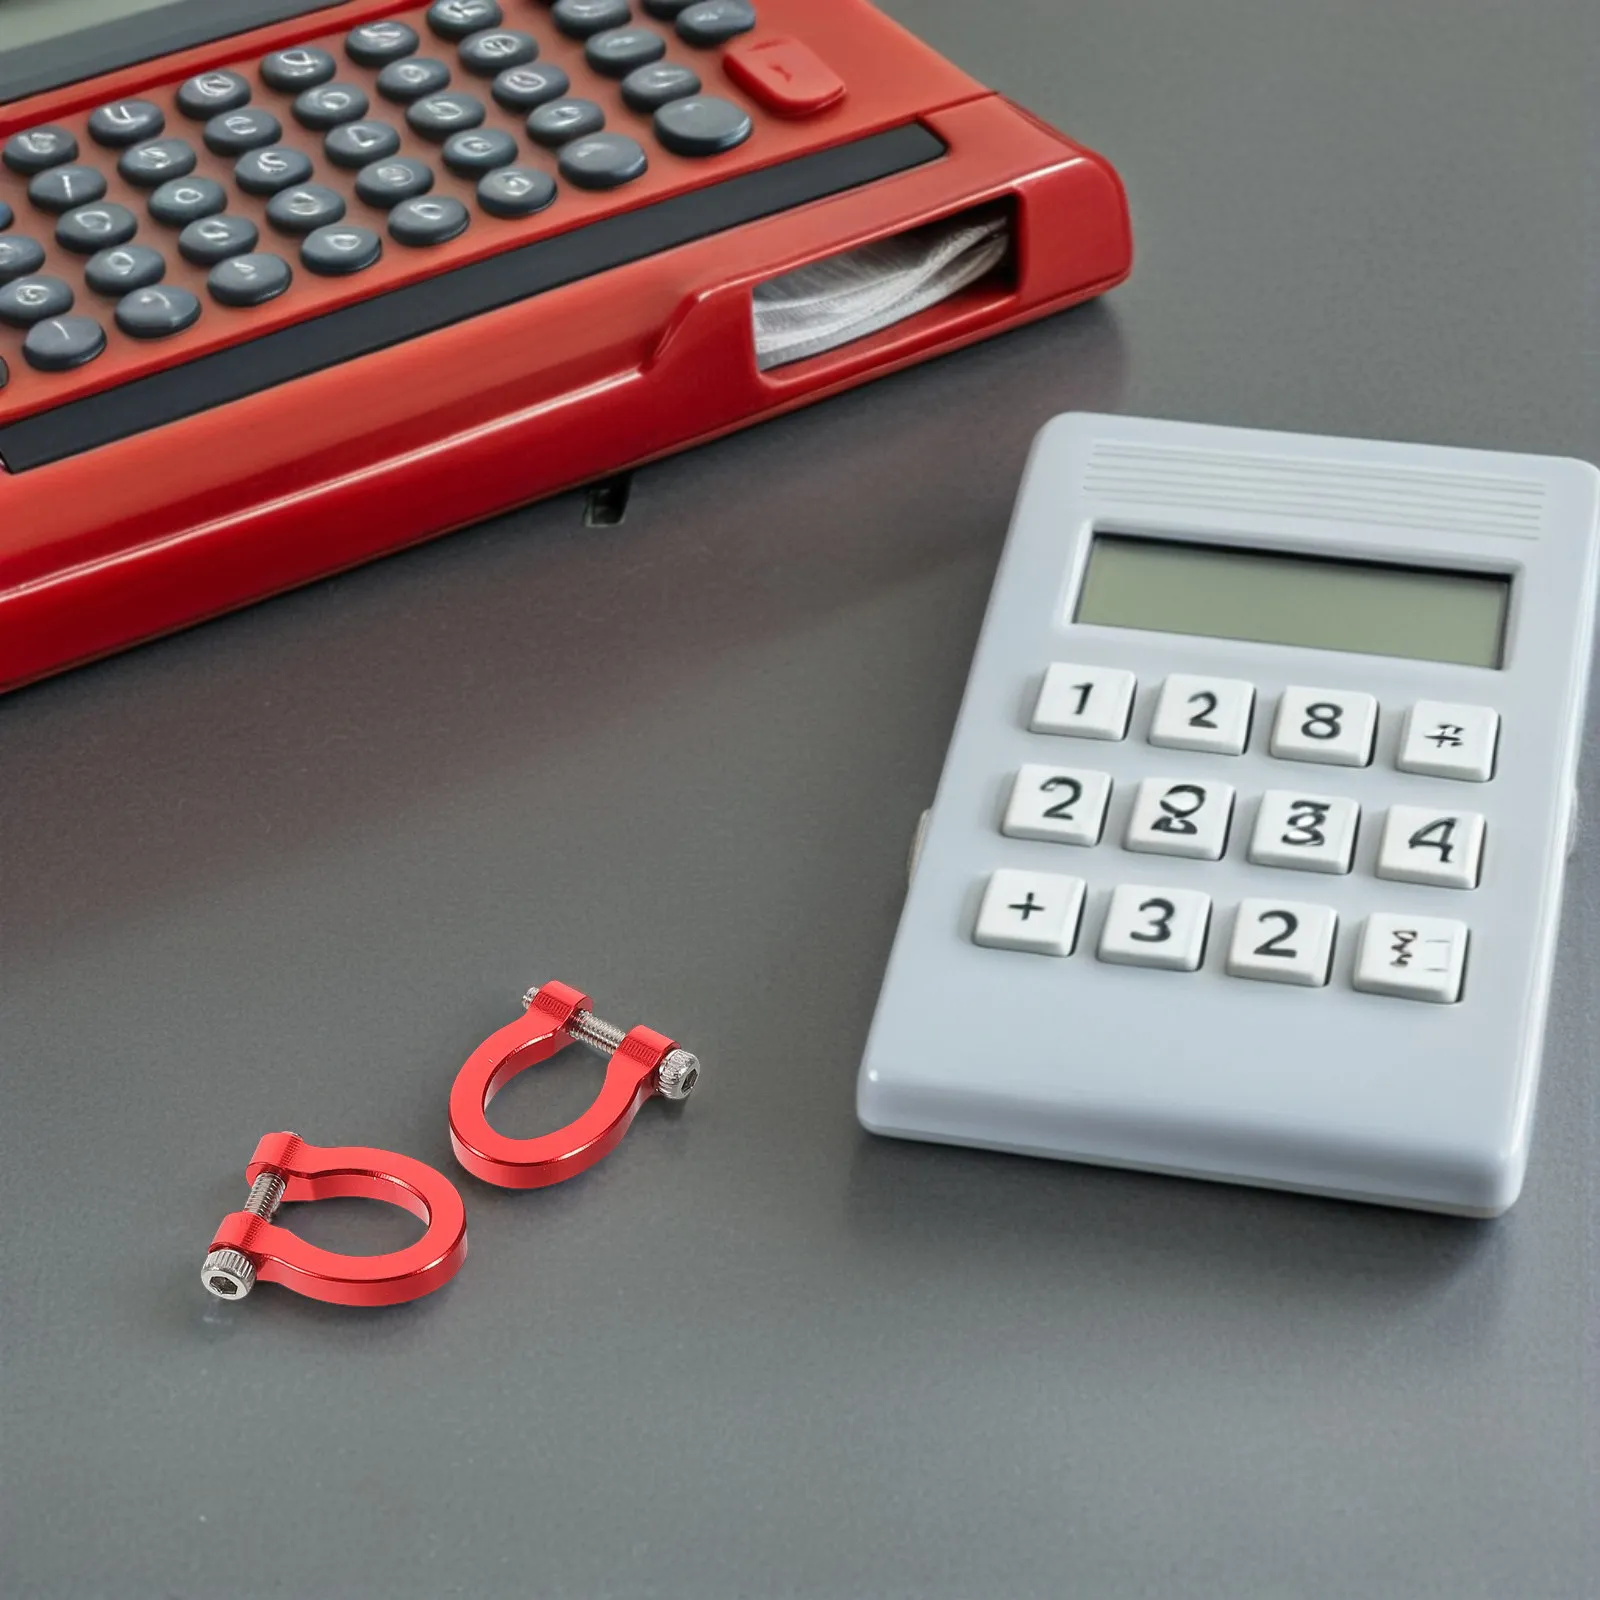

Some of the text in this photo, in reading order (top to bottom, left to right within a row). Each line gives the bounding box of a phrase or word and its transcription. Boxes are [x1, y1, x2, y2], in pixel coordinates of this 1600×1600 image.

[1070, 682, 1094, 716] 1
[1187, 691, 1218, 730] 2
[1300, 702, 1344, 740] 8
[1039, 776, 1083, 821] 2
[1408, 817, 1457, 864] 4
[1129, 897, 1176, 943] 3
[1253, 909, 1299, 959] 2
